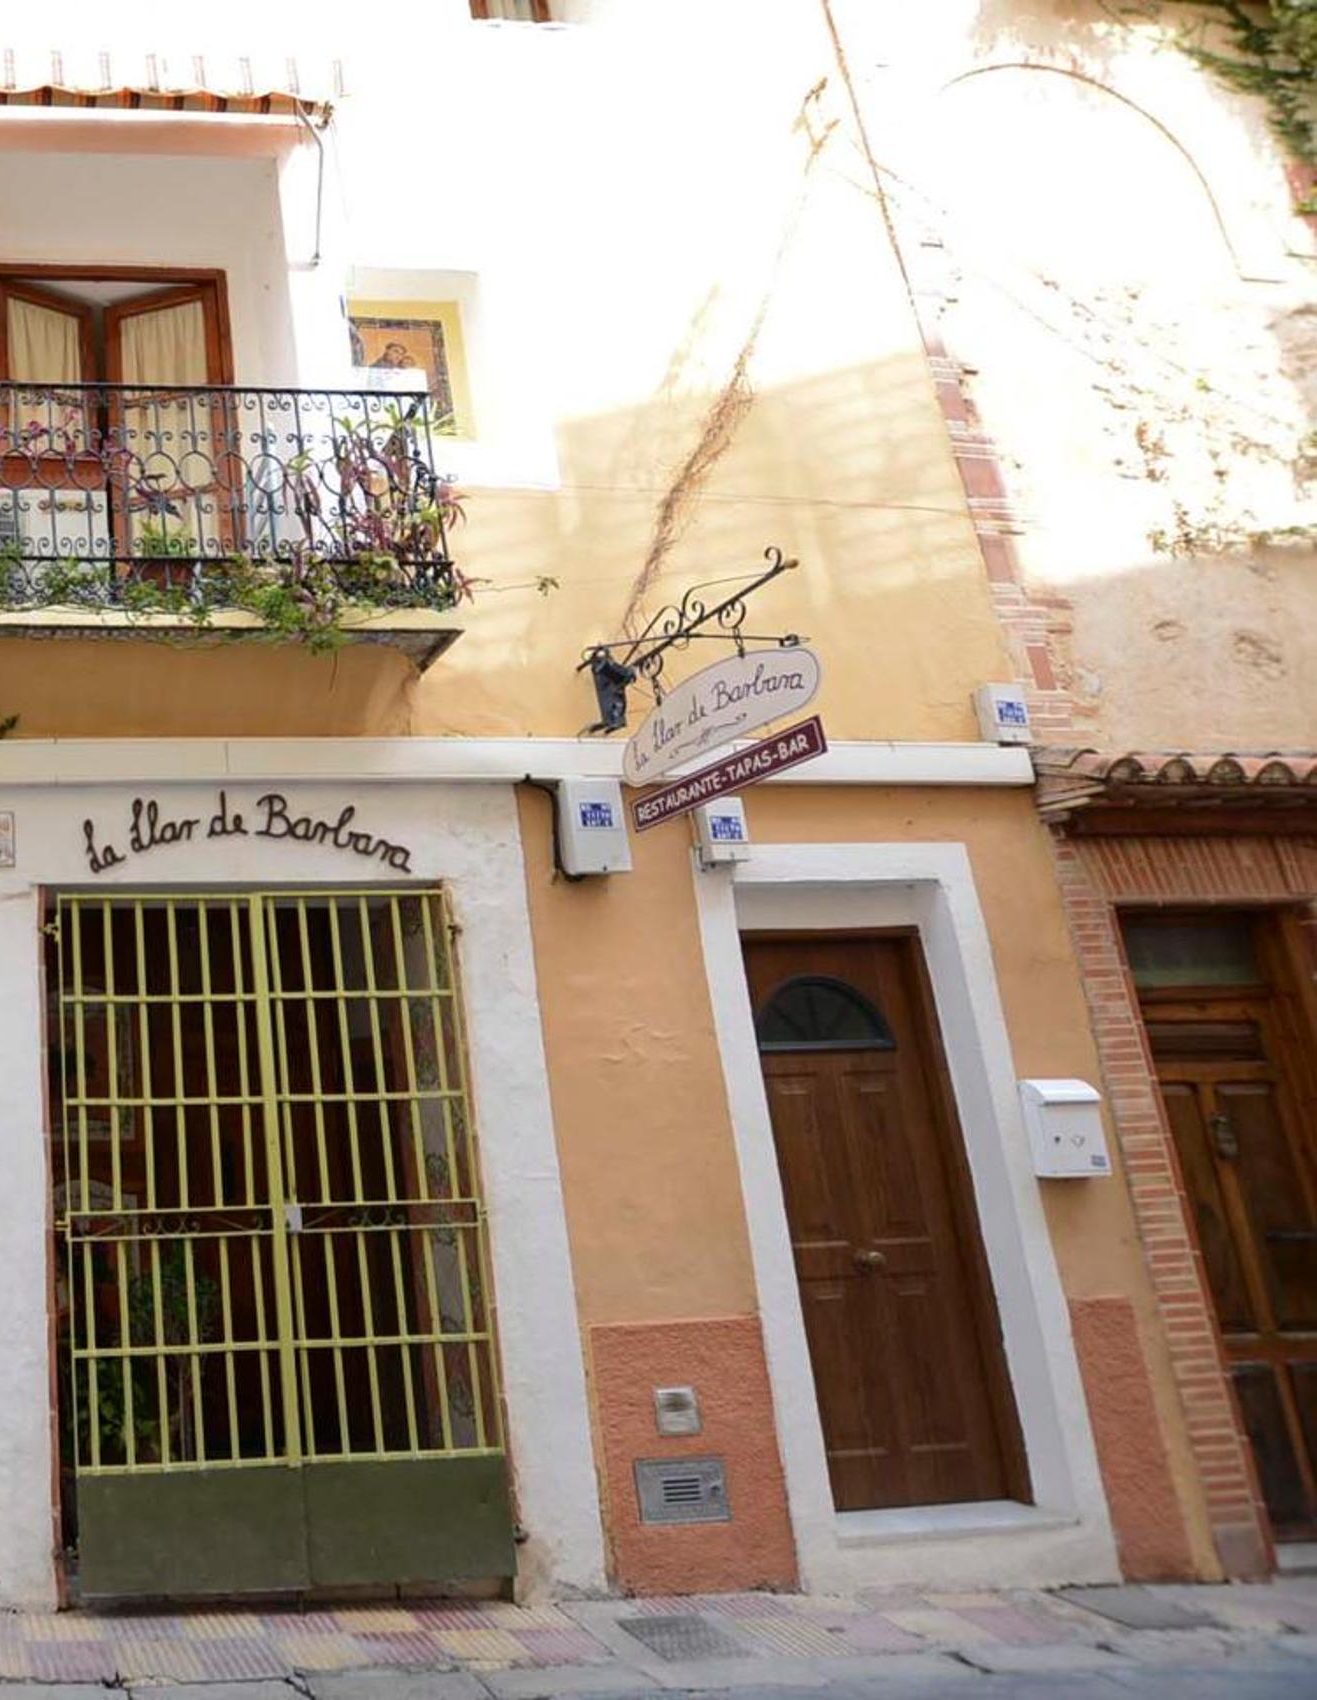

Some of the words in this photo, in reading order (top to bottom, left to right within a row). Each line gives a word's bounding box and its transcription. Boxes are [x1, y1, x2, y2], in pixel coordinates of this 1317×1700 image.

[633, 740, 650, 772] La
[653, 718, 683, 753] Llar
[688, 694, 707, 726] de
[711, 663, 804, 713] Barbara
[636, 733, 810, 823] RESTAURANTE-TAPAS-BAR
[83, 818, 127, 874] La
[129, 797, 201, 853] Llar
[206, 789, 249, 839] de
[255, 794, 412, 874] Barbara
